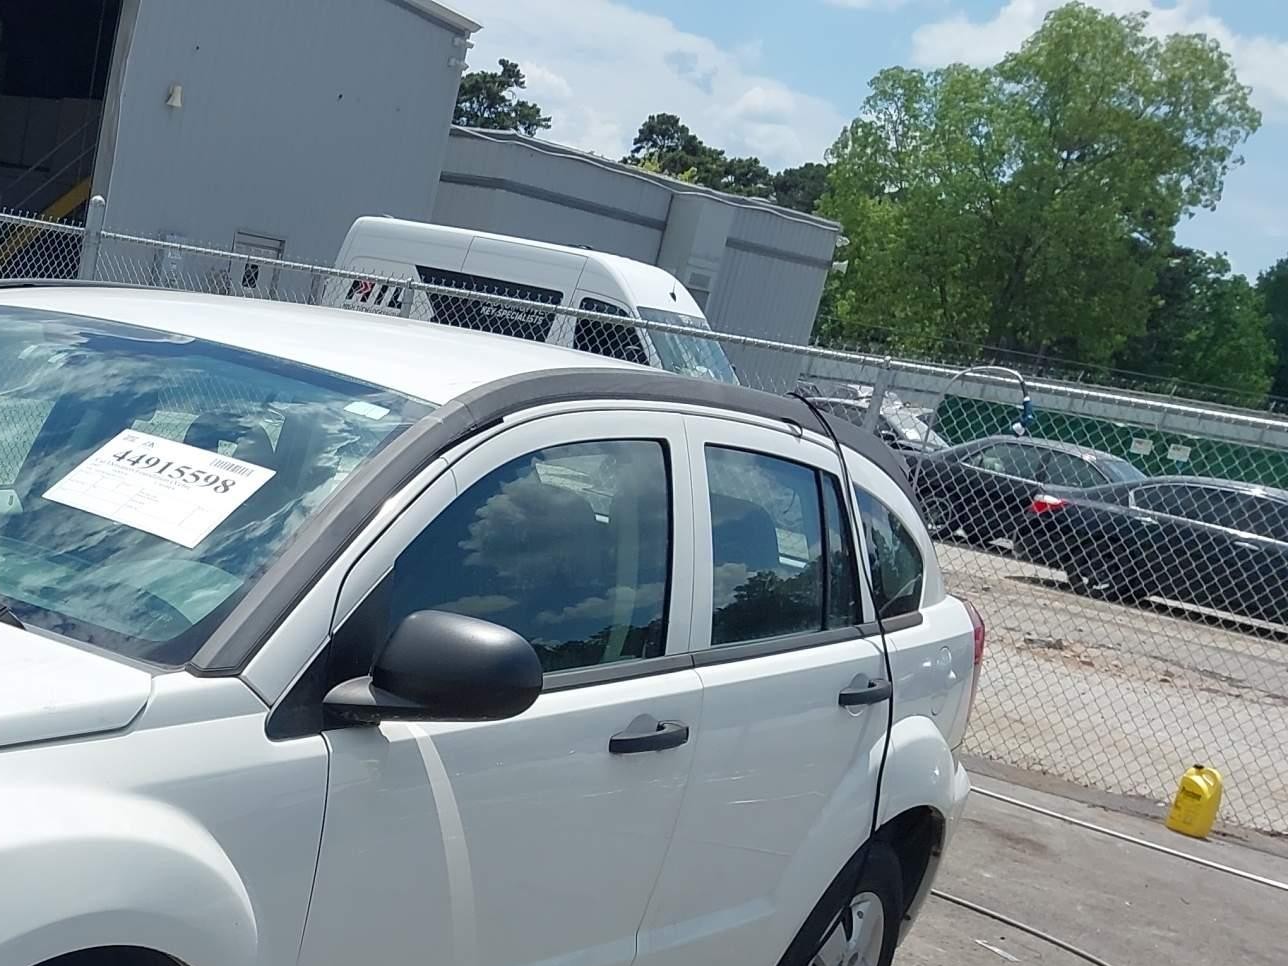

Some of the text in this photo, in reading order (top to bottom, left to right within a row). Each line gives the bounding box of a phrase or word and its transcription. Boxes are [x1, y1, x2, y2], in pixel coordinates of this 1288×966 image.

[479, 305, 544, 325] KEY SPECIALISTS
[112, 449, 236, 494] 44915598
